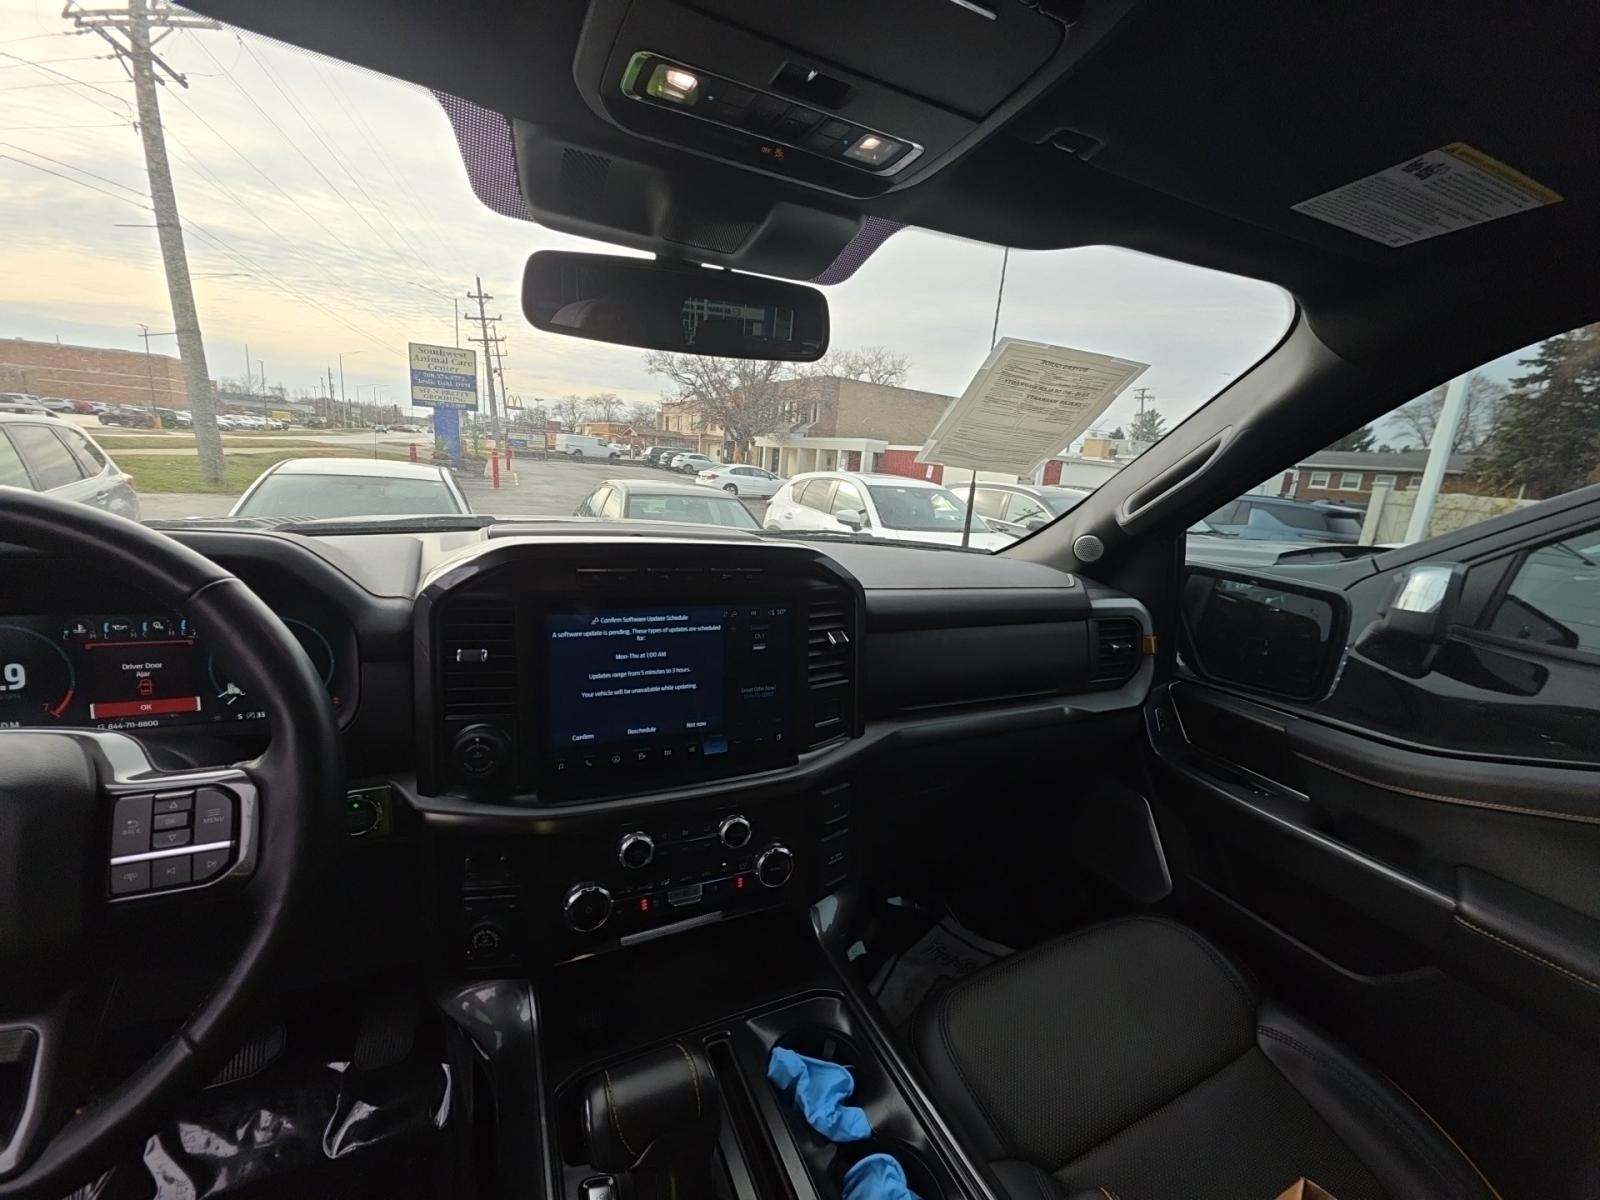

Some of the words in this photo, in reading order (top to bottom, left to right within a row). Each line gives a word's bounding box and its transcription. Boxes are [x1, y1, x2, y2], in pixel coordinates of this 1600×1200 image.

[418, 347, 466, 358] Southwest
[414, 354, 448, 365] Animal
[451, 358, 473, 367] Care
[427, 363, 460, 372] Center
[631, 686, 660, 694] unavailable
[627, 727, 657, 735] Reschedule
[572, 733, 595, 741] Confirm
